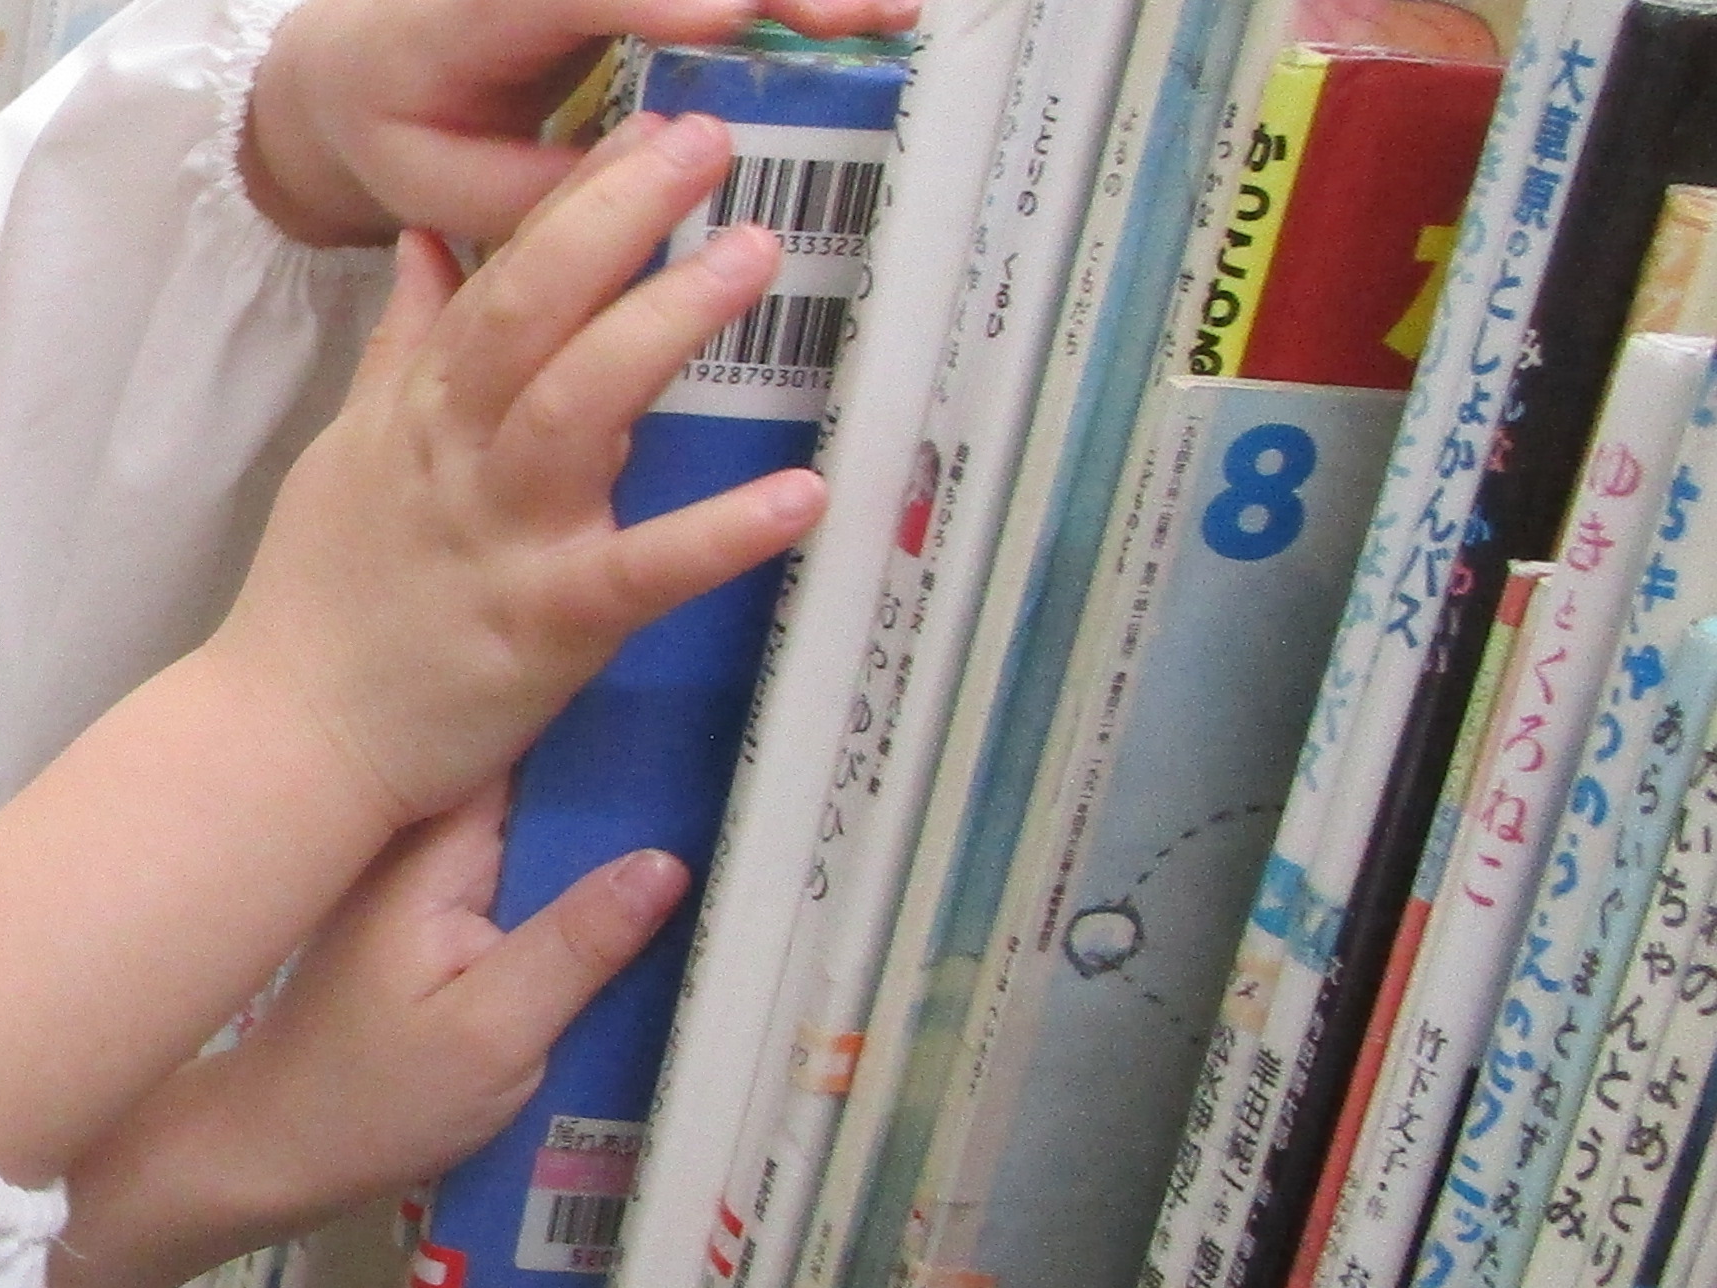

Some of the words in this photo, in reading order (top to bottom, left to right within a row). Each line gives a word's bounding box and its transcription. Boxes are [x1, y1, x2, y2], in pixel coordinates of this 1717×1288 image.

[1200, 422, 1317, 562] 8
[1386, 38, 1596, 650] 大草原のとしょかんバス
[1464, 441, 1644, 908] ゆきとくろねこ
